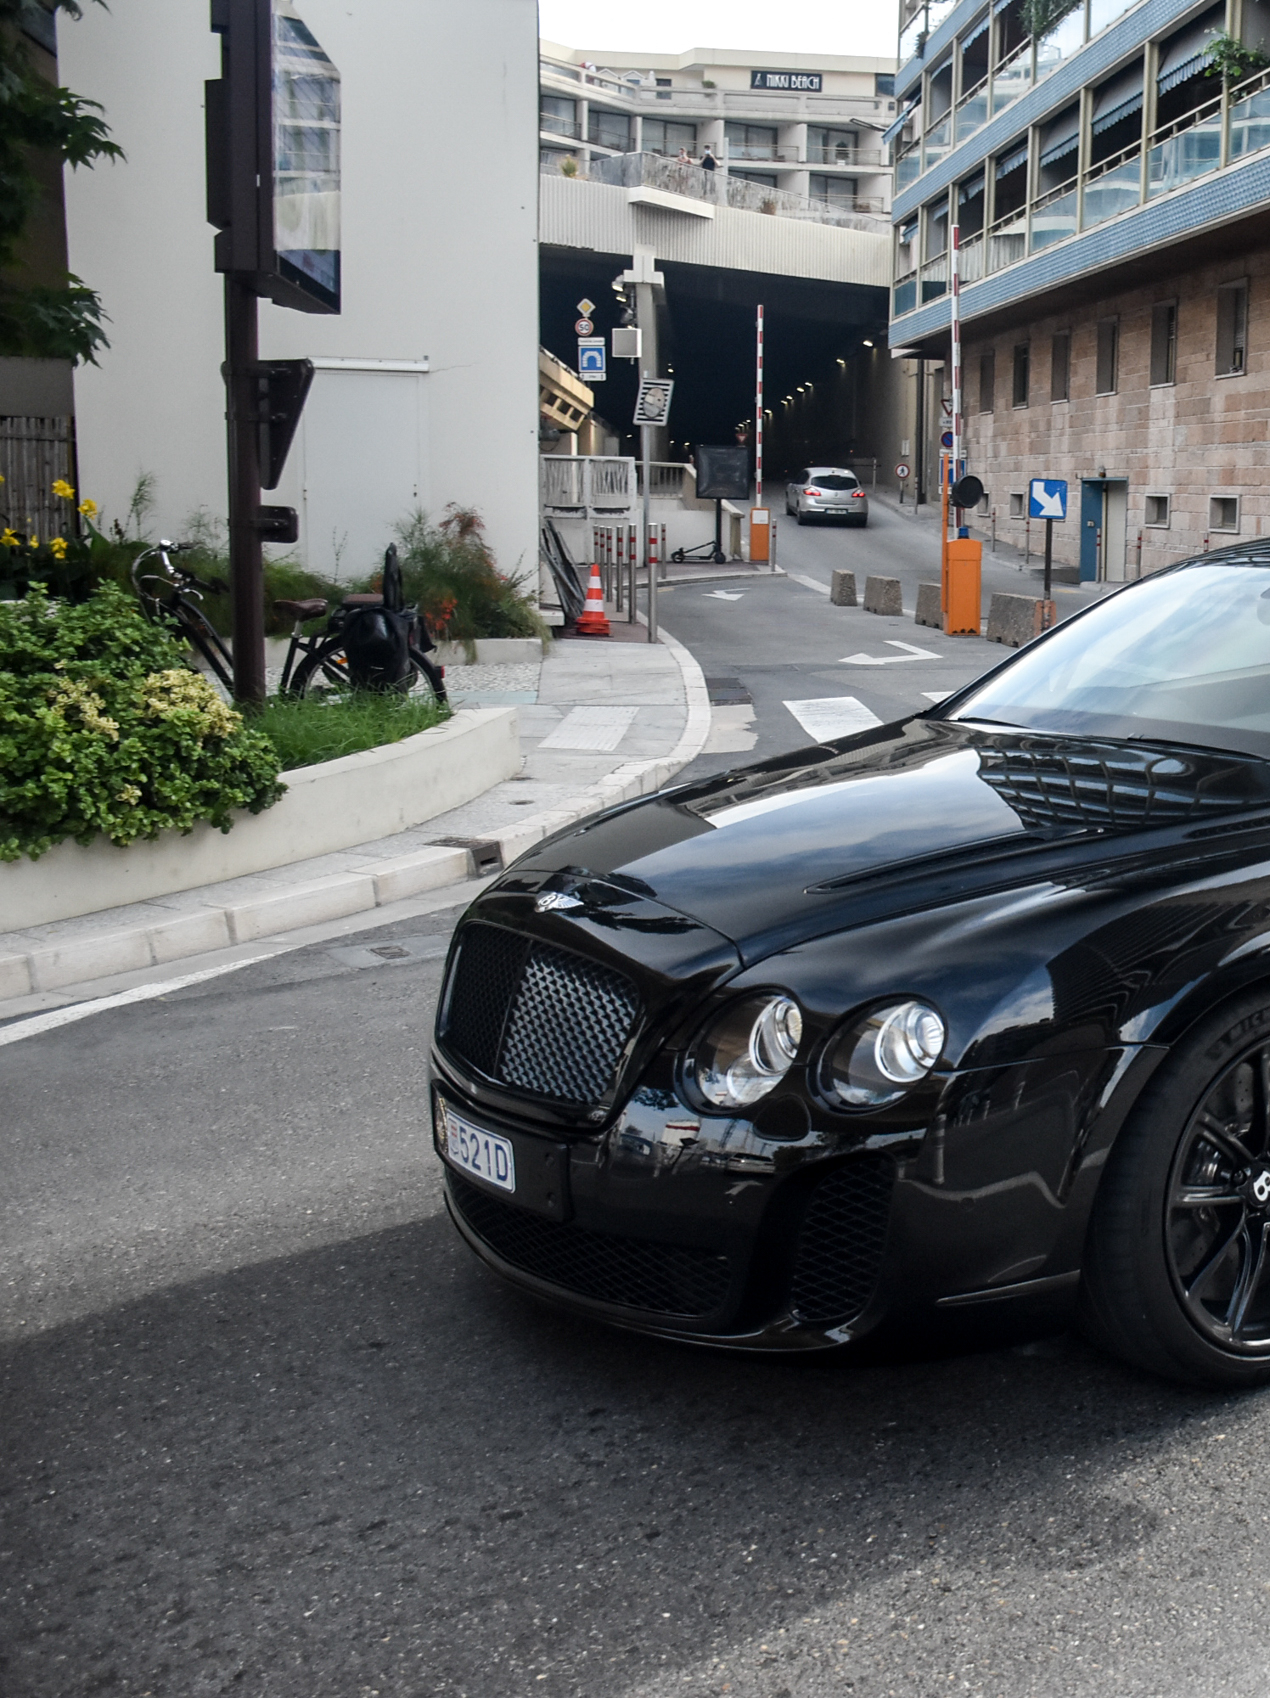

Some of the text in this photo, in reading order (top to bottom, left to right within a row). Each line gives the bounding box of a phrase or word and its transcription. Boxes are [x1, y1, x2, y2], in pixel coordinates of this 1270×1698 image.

[766, 74, 819, 89] NIKKI BEACH
[459, 1126, 508, 1181] 521D
